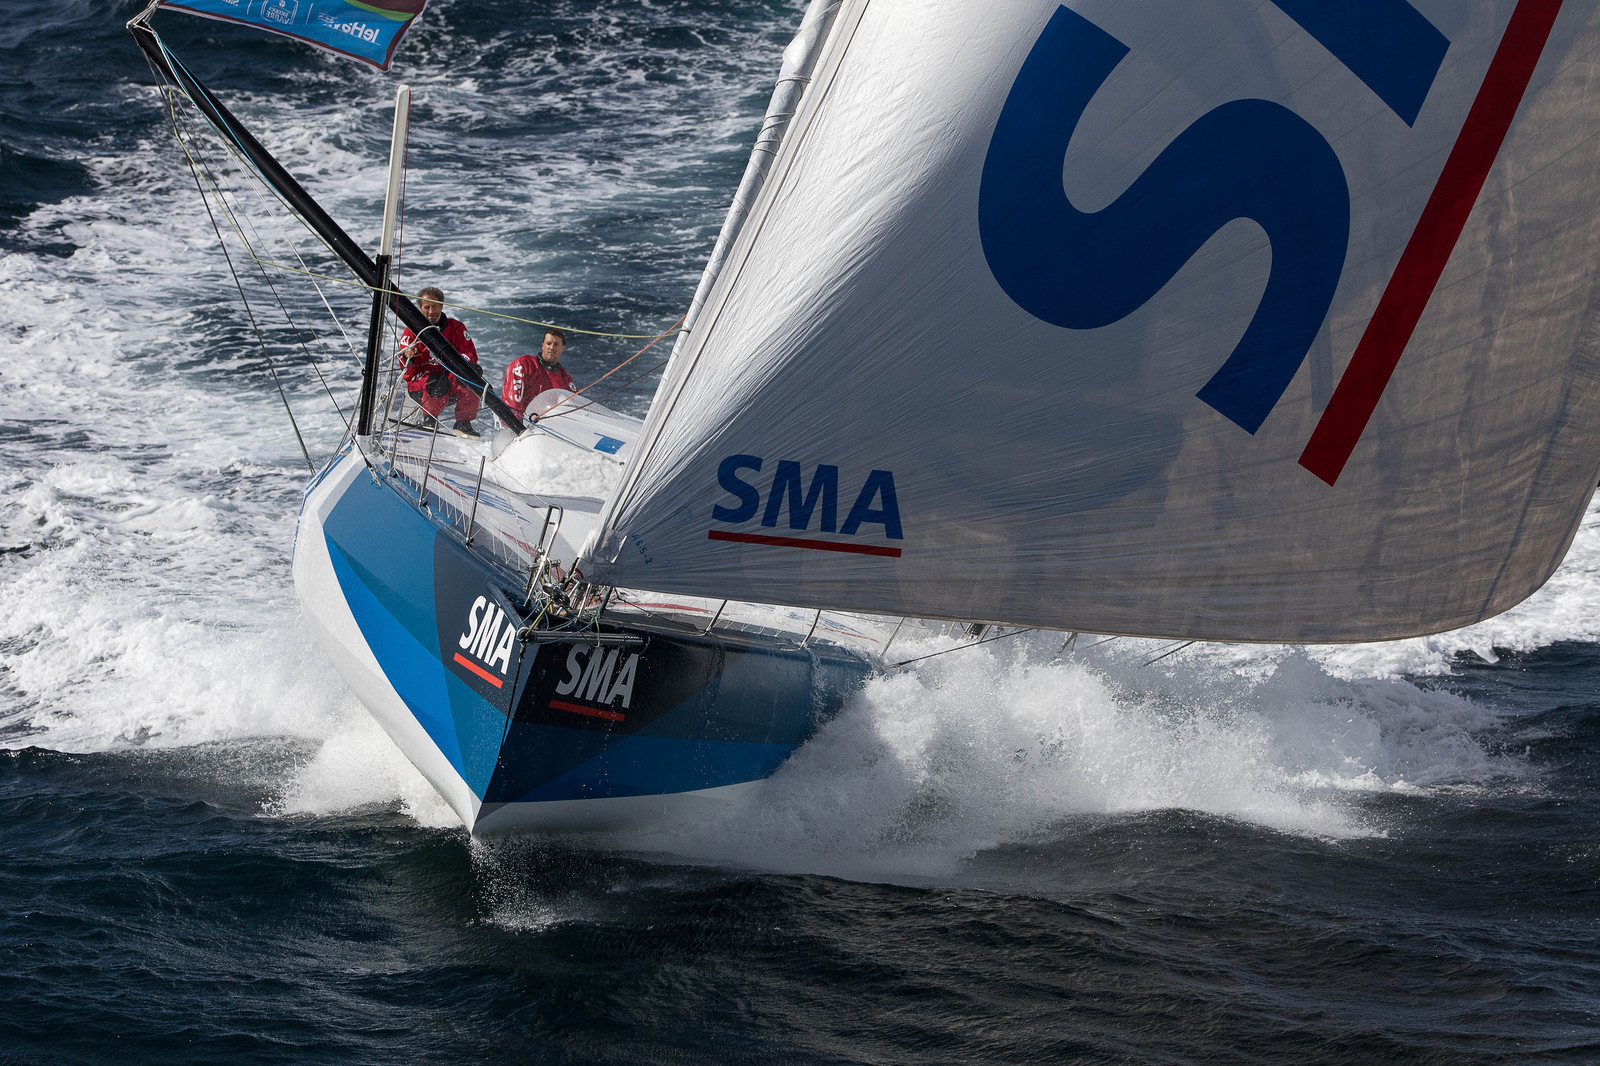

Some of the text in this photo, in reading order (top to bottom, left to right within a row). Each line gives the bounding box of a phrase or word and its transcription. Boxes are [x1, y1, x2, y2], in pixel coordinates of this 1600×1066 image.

[978, 0, 1450, 436] S
[711, 454, 904, 540] SMA
[458, 595, 517, 675] SMA
[555, 643, 639, 708] SMA
